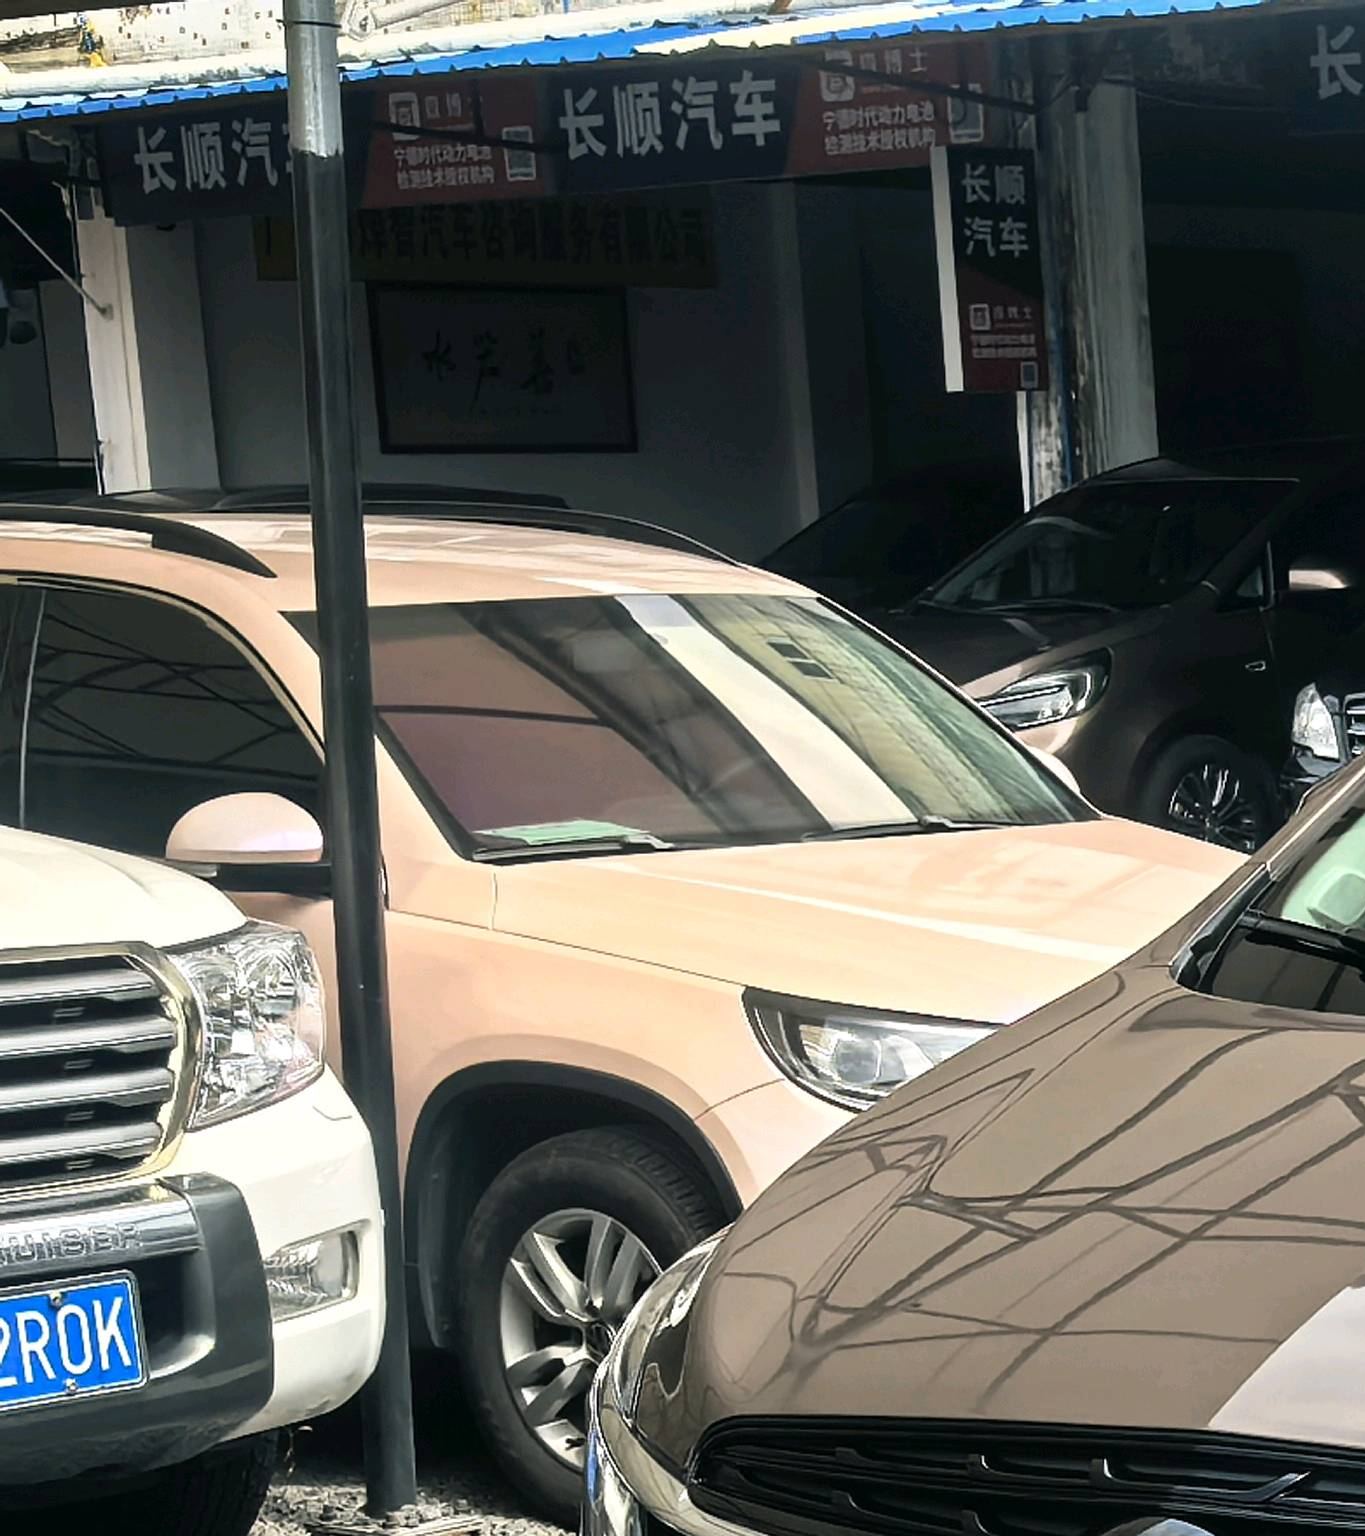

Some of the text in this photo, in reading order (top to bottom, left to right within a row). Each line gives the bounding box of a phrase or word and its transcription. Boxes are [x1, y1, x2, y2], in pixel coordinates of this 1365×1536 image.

[560, 69, 782, 161] 长顺汽车
[133, 117, 294, 195] 长顺汽
[962, 164, 1026, 206] 长顺
[963, 215, 1030, 260] 汽车
[0, 1223, 143, 1265] UISER
